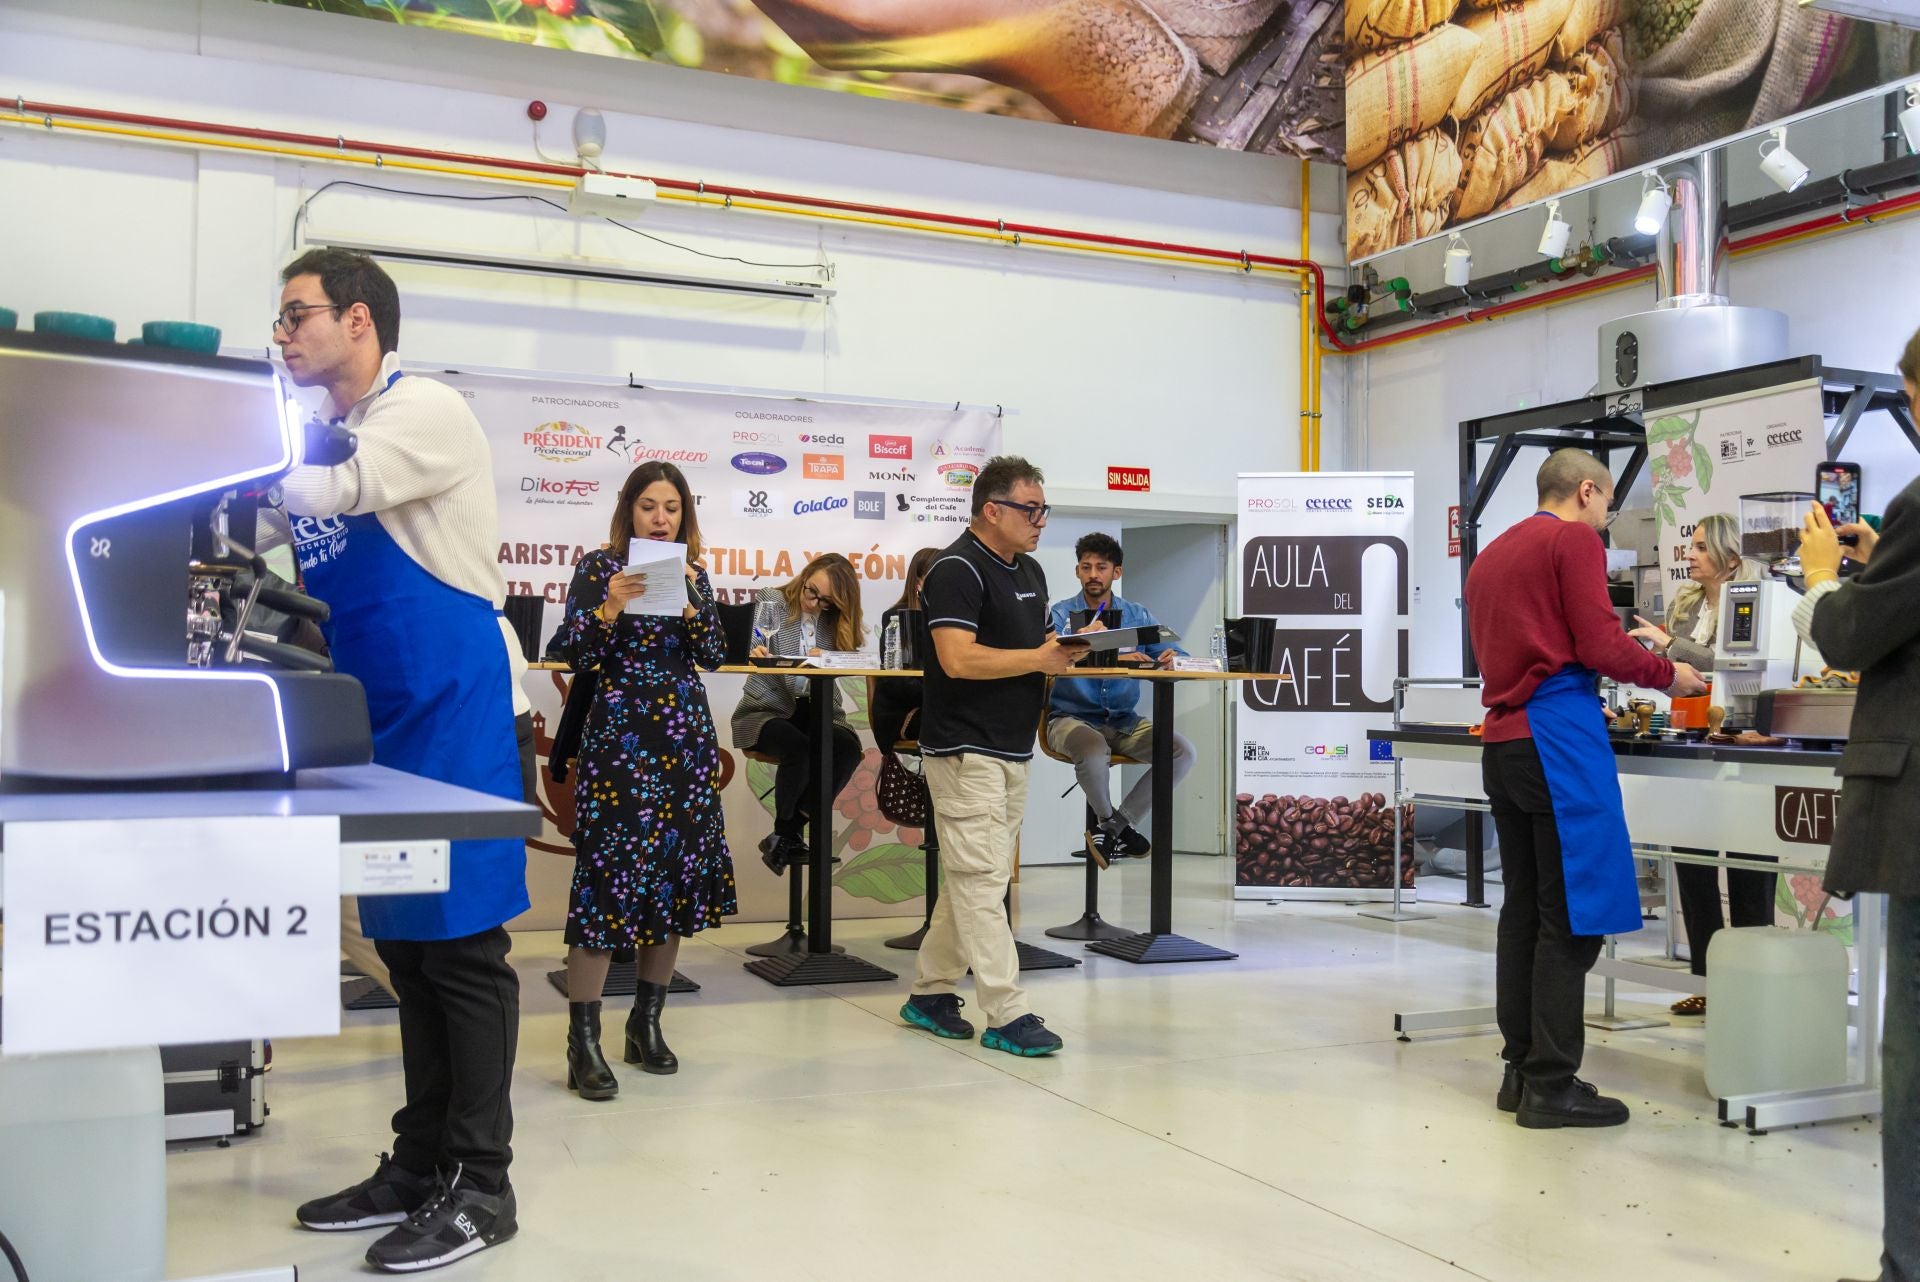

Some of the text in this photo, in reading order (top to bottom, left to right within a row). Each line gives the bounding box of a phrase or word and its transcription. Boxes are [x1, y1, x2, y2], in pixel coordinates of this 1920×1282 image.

[523, 431, 602, 450] PRÉSIDENT
[733, 431, 782, 443] PROSOL
[811, 434, 844, 445] seda
[534, 446, 591, 457] Profesional
[874, 443, 907, 455] Biscoff
[808, 462, 838, 474] TRAPA
[1108, 472, 1150, 487] SIN SALIDA
[793, 496, 848, 515] ColaCao
[910, 496, 966, 504] Complementos
[1248, 498, 1298, 509] PROSOL
[1306, 498, 1352, 509] cetece
[1367, 496, 1404, 508] SEDA
[934, 515, 957, 523] Radio
[498, 542, 585, 566] ARISTA
[1673, 545, 1687, 562] DE
[1250, 544, 1329, 588] AULA
[1334, 593, 1353, 609] DEL
[1305, 744, 1348, 755] edusi
[45, 898, 308, 946] ESTACIÓN 2
[455, 1212, 478, 1236] EA7
